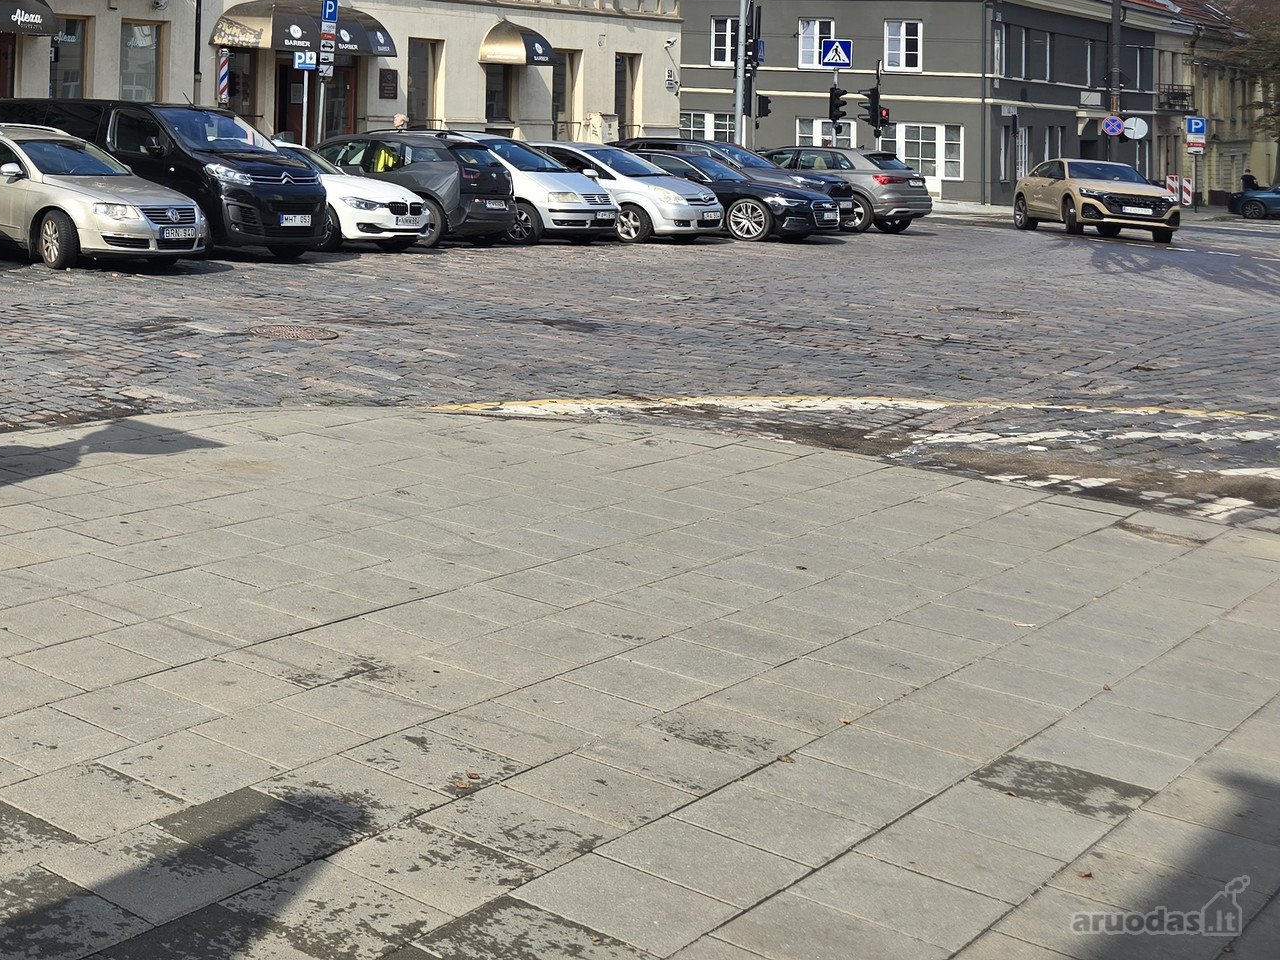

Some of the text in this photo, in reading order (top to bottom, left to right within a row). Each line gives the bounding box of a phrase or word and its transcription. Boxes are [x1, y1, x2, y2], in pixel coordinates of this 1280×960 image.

[11, 8, 43, 26] Alexa
[325, 0, 335, 19] P
[284, 39, 311, 47] BARBER
[296, 52, 305, 69] P
[1191, 119, 1203, 133] P
